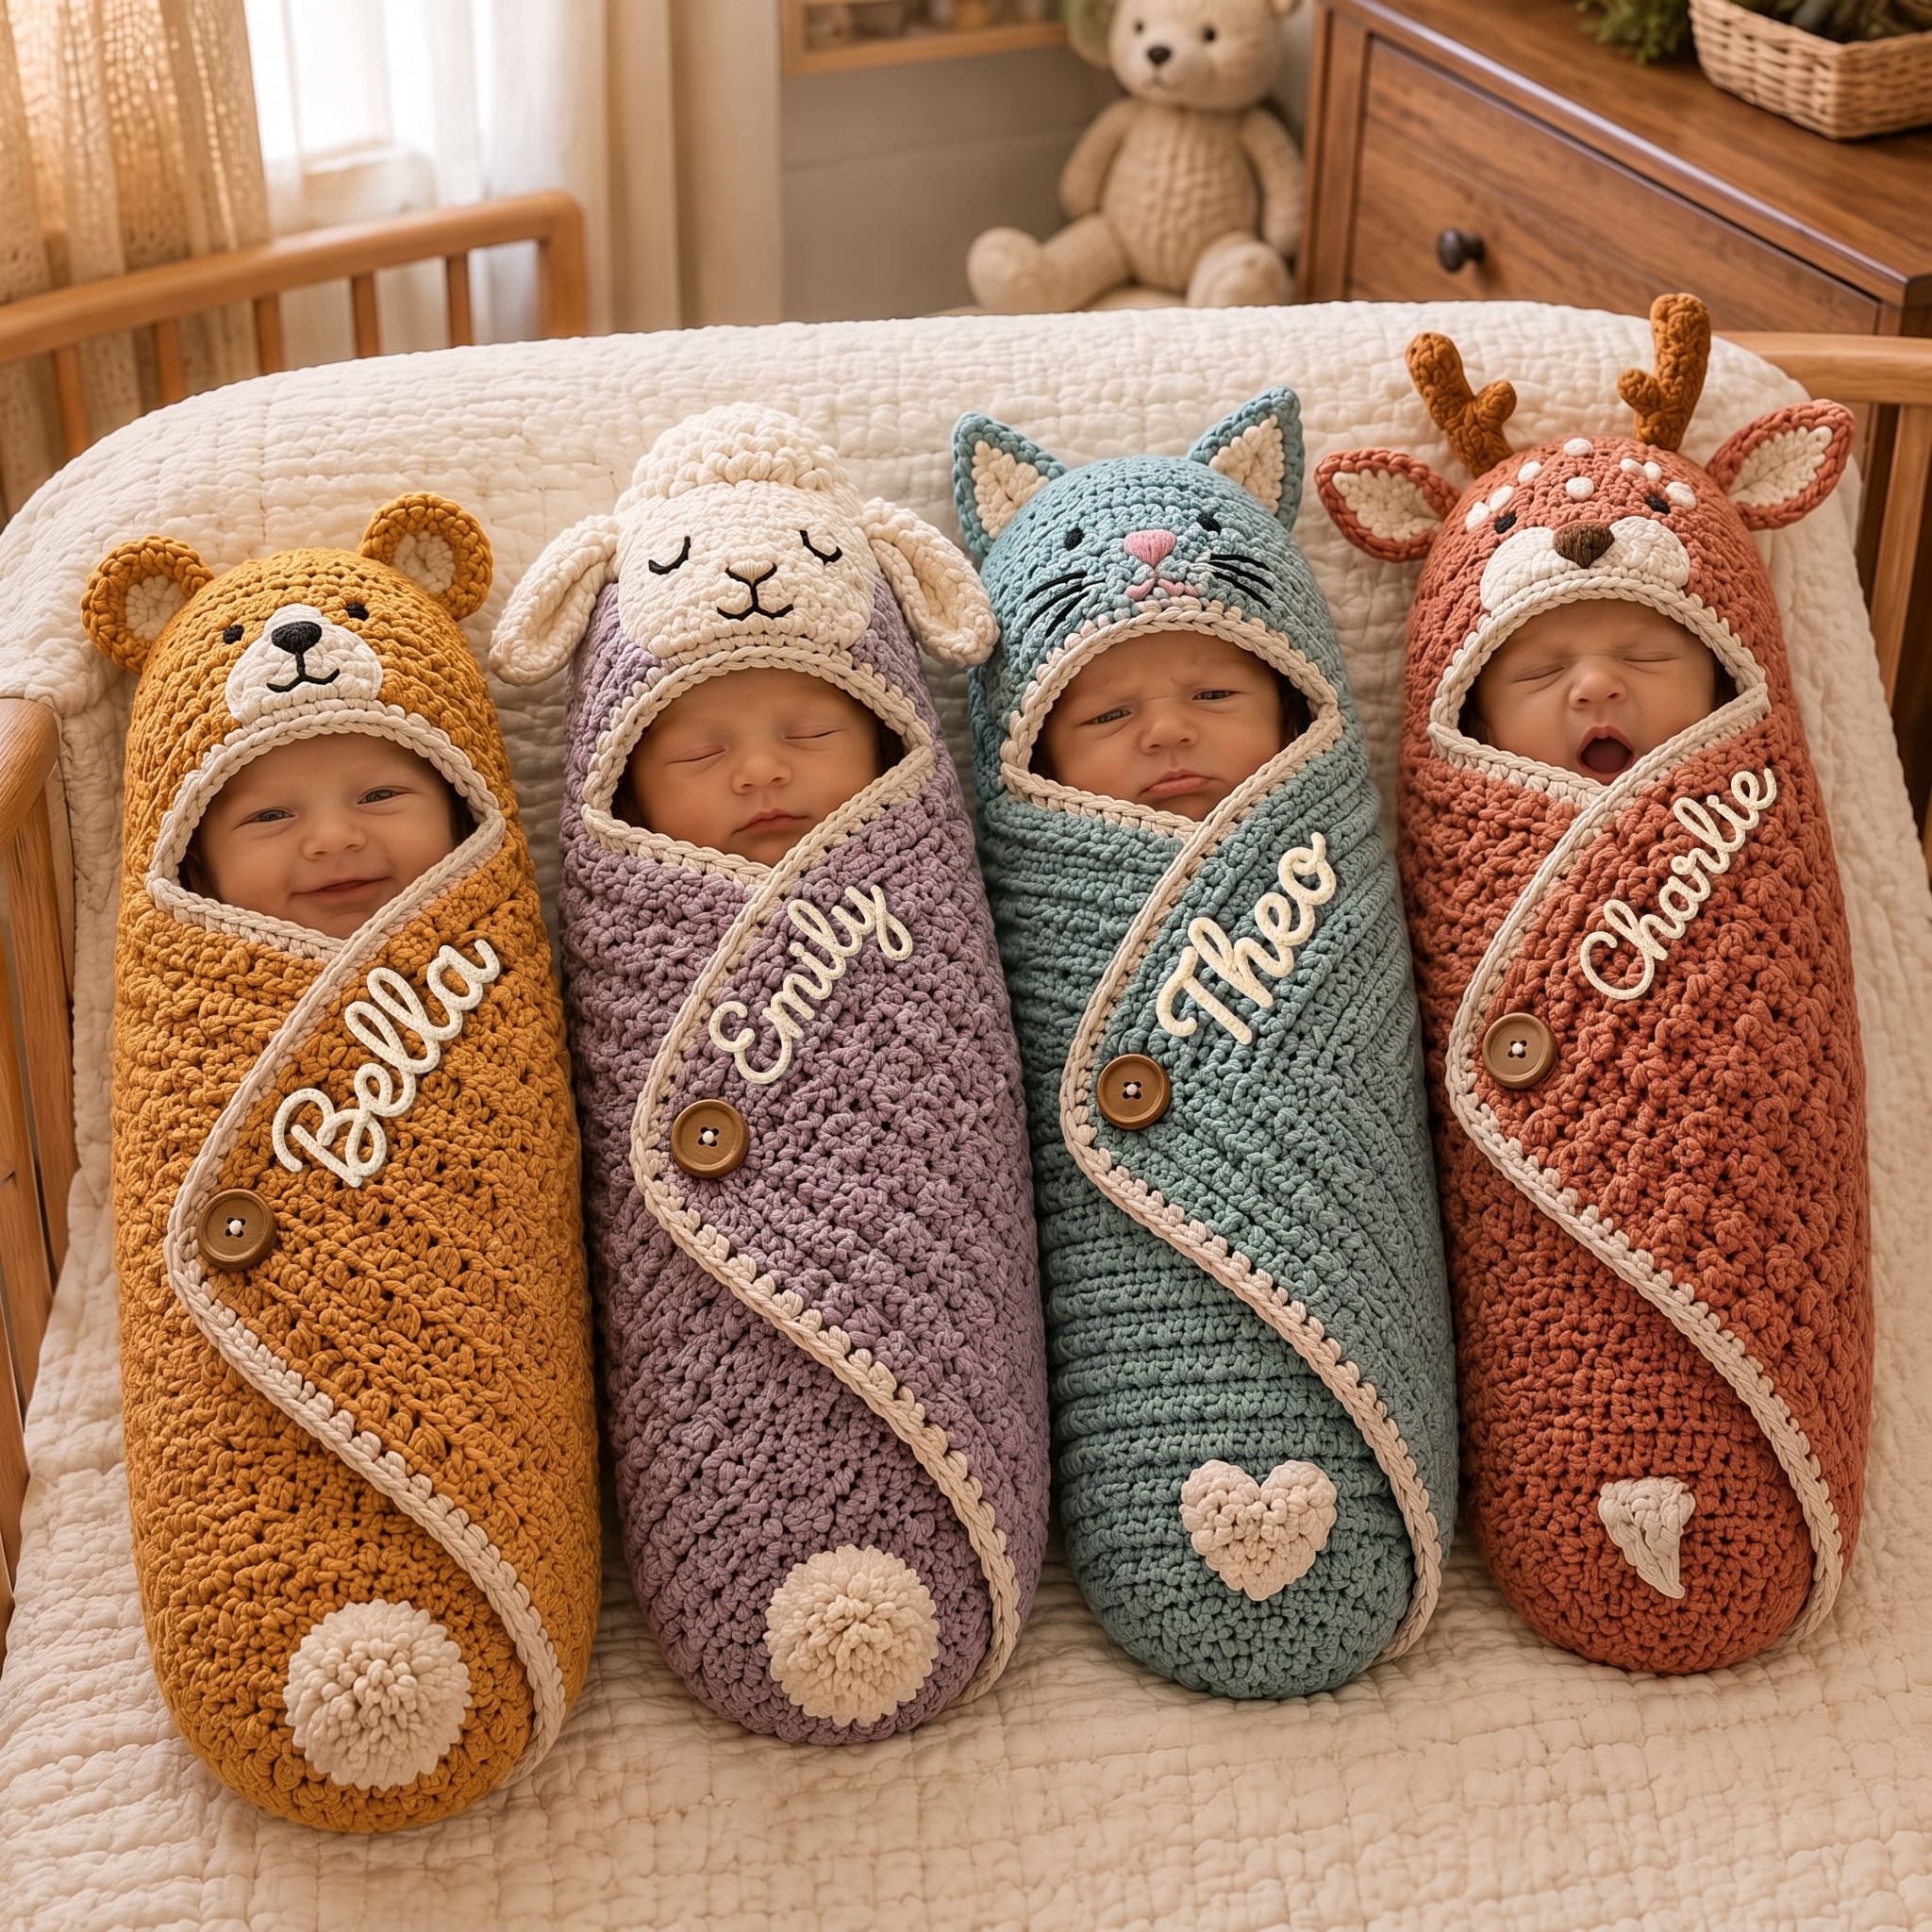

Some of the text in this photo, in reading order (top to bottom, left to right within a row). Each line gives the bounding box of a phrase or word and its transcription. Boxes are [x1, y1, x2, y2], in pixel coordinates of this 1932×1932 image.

[708, 885, 912, 1084] Emily
[1156, 831, 1336, 1045] Theo
[1580, 768, 1776, 1000] Charlie
[272, 939, 500, 1188] Bella
